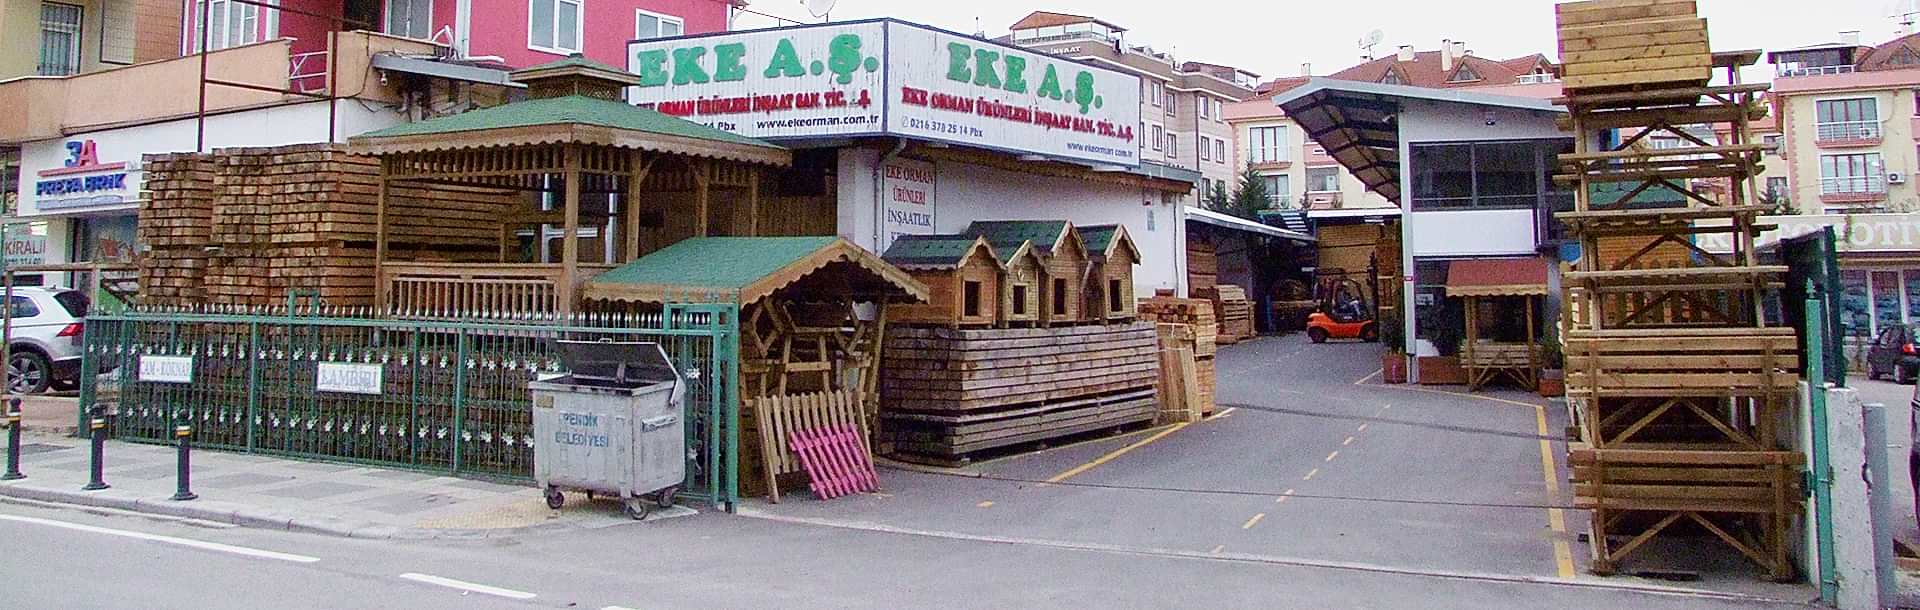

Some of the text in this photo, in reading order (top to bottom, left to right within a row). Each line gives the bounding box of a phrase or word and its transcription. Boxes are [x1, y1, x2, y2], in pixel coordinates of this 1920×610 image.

[637, 34, 879, 87] EKE A.Ş.
[946, 41, 1103, 114] EKE A.Ş.
[902, 86, 928, 106] EKE
[931, 92, 974, 114] ORMAN
[976, 96, 1033, 123] ÜRÜNLERİ
[1033, 106, 1072, 132] İNŞAAT
[718, 121, 737, 131] Pbx
[756, 114, 880, 129] www.ekeorman.com.tr
[910, 118, 930, 130] 0216
[947, 123, 957, 134] 25
[65, 139, 99, 167] 3A
[886, 165, 902, 179] EKE
[560, 412, 598, 427] PENDİK
